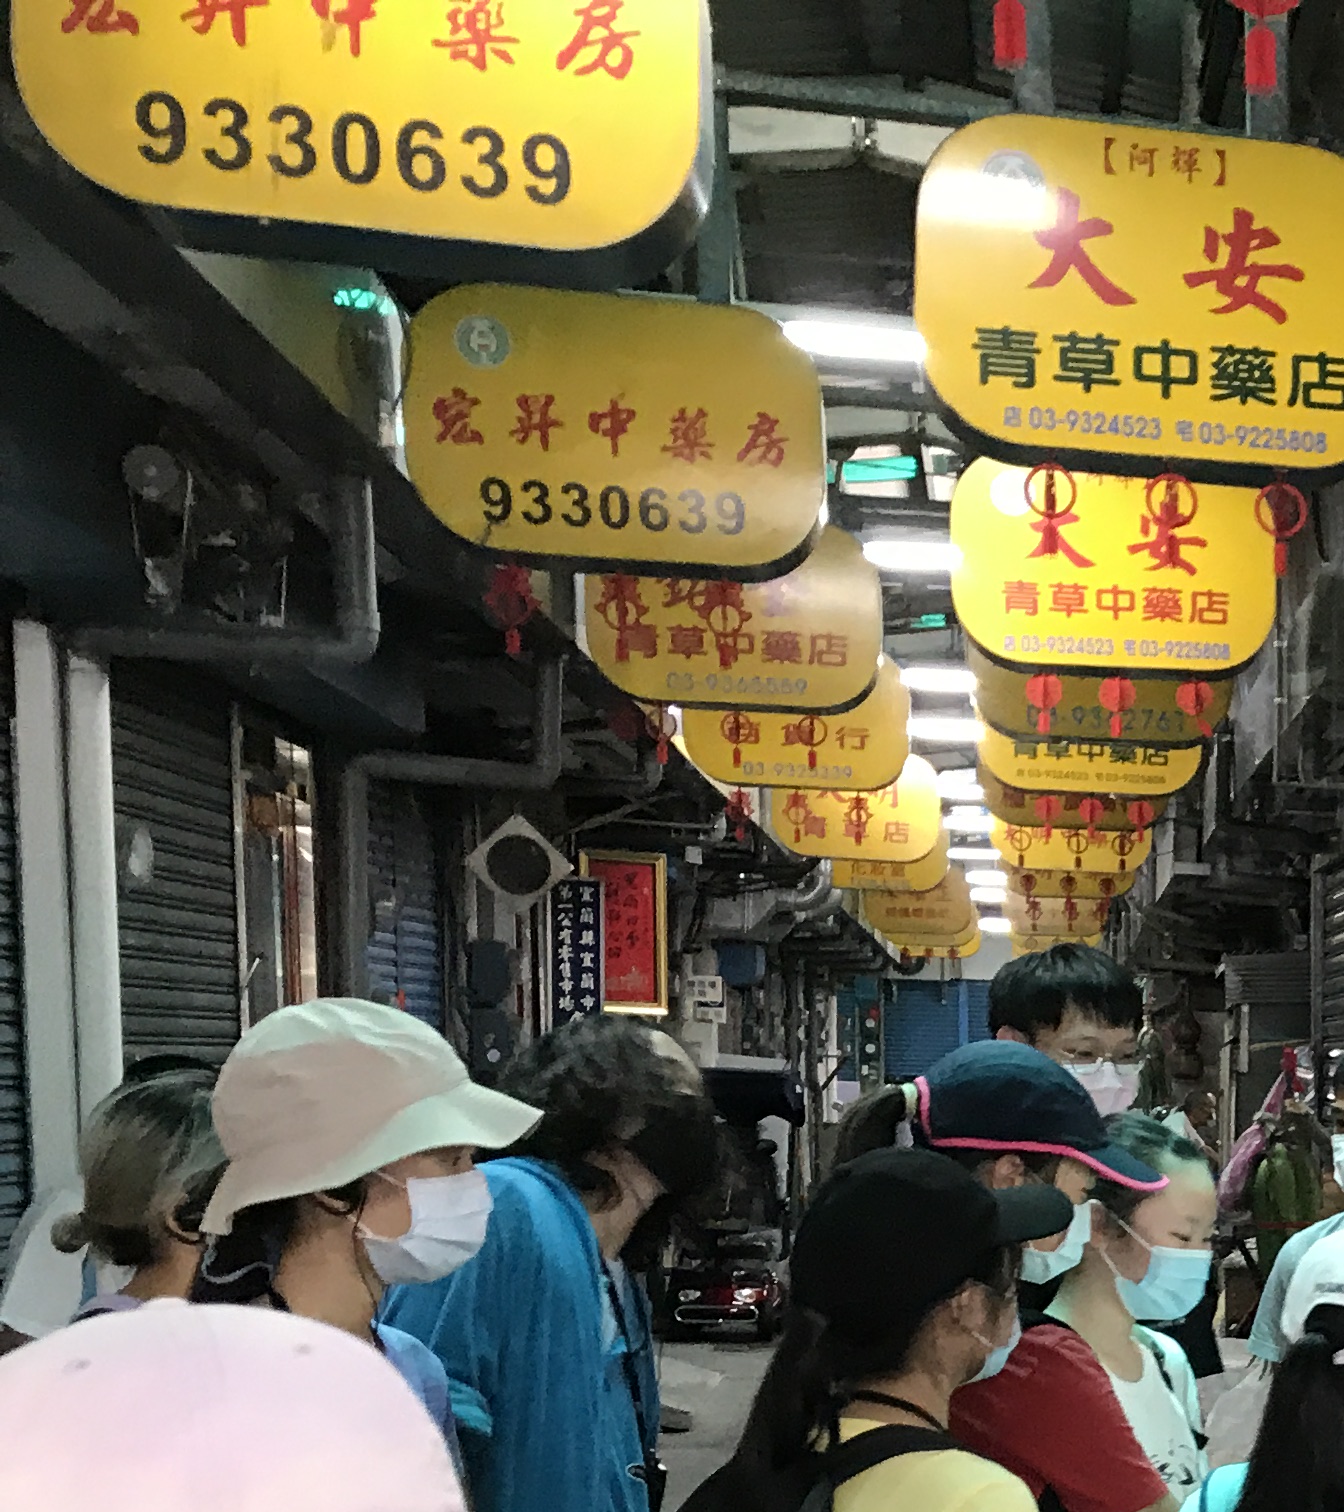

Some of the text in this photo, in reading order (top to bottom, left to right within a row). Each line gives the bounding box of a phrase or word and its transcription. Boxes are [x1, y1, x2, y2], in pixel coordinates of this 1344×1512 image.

[134, 90, 572, 206] 9330639
[1027, 186, 1304, 325] 大安
[1028, 406, 1162, 441] 03-9324523
[479, 476, 747, 537] 9330639
[1026, 500, 1208, 576] 大安
[1001, 580, 1230, 625] 青草中藥店
